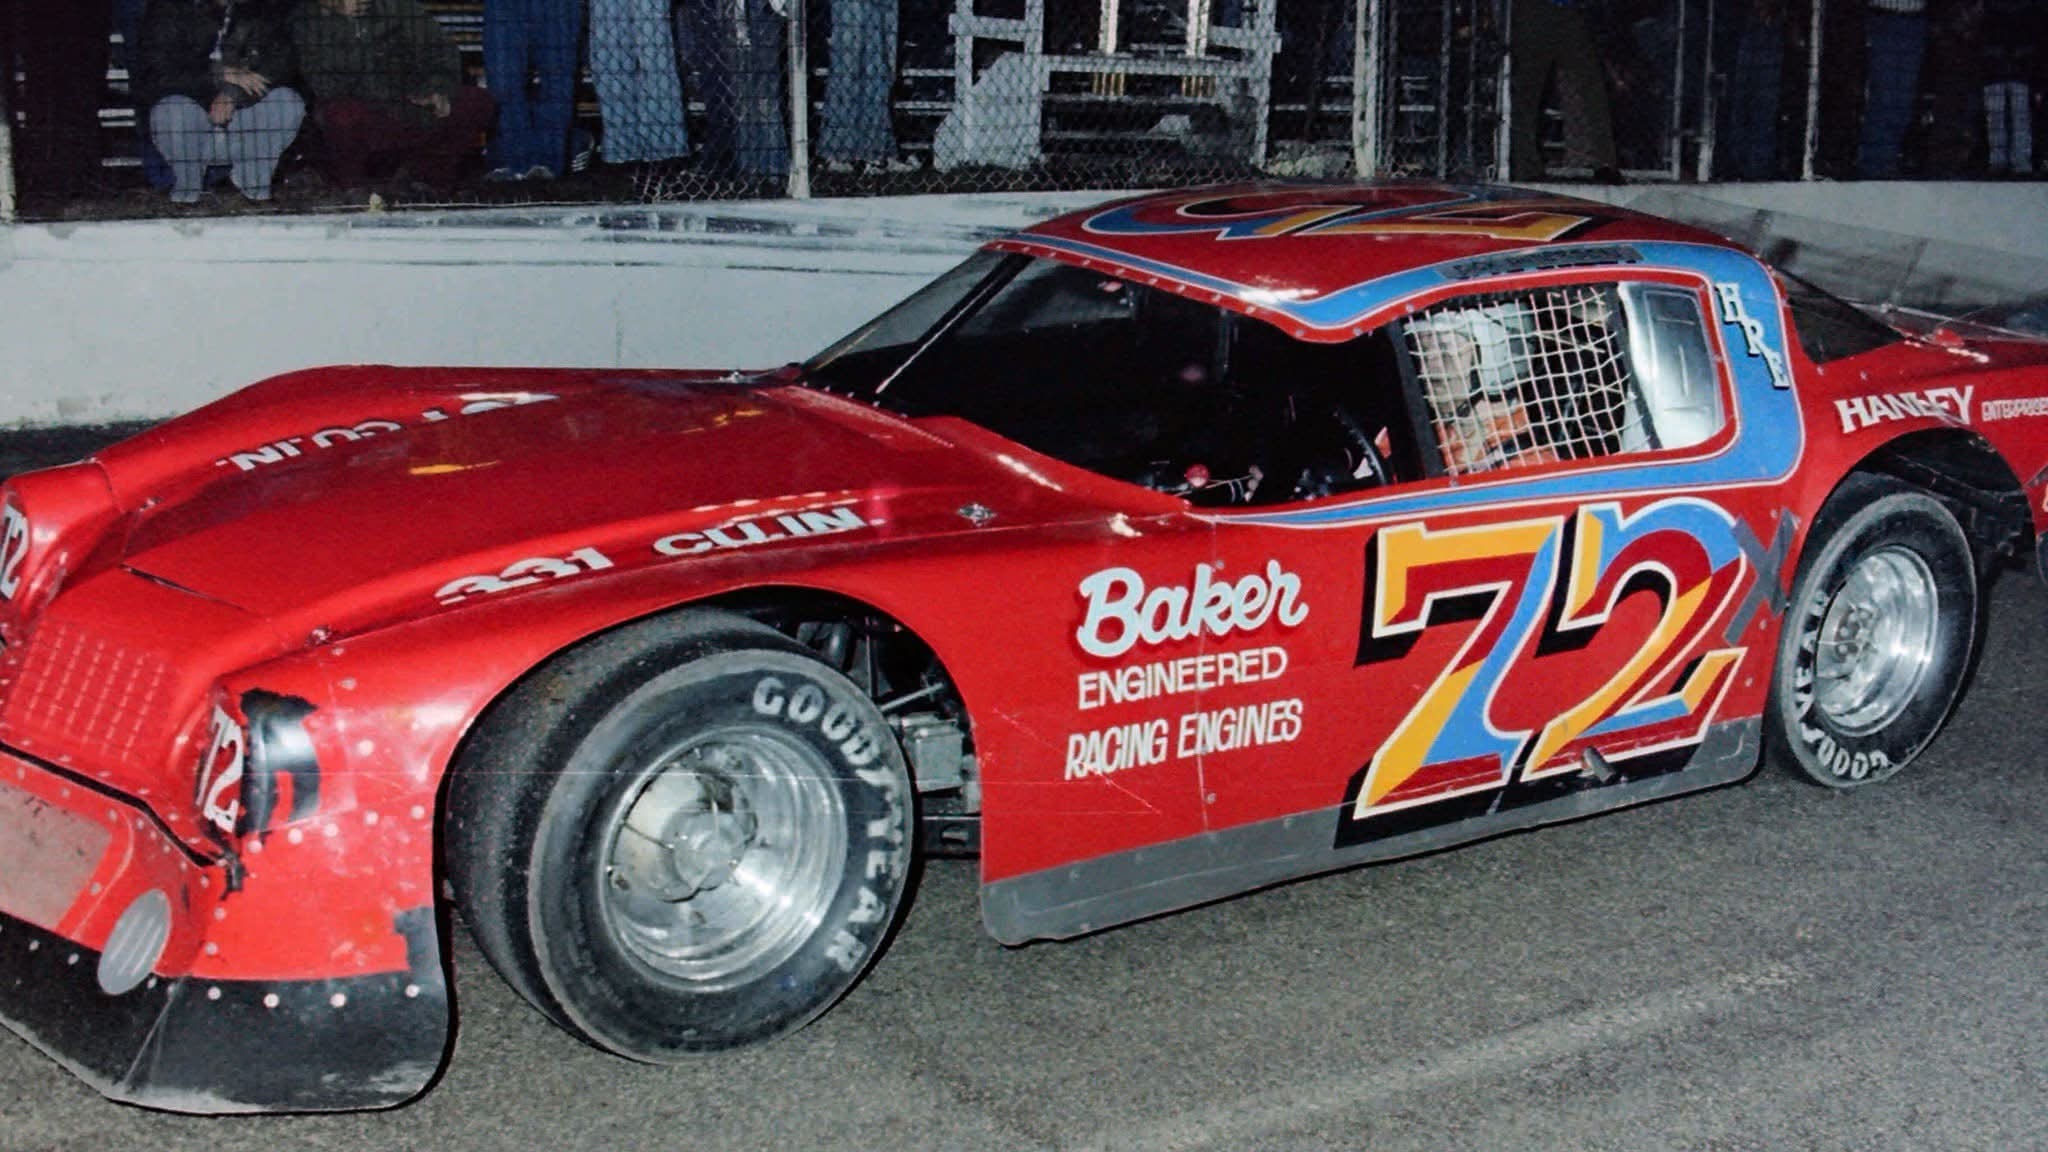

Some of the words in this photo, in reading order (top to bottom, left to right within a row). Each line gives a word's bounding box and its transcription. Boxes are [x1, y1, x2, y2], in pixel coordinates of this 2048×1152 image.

[1716, 282, 1790, 389] HRE
[1833, 385, 1974, 434] HANLEY
[1076, 559, 1310, 658] Baker
[1352, 496, 1750, 822] 72
[1078, 646, 1288, 711] ENGINEERED
[195, 703, 245, 834] 72
[1064, 719, 1169, 781] RACING
[1176, 698, 1303, 759] ENGINES
[752, 675, 903, 973] GOODYEAR
